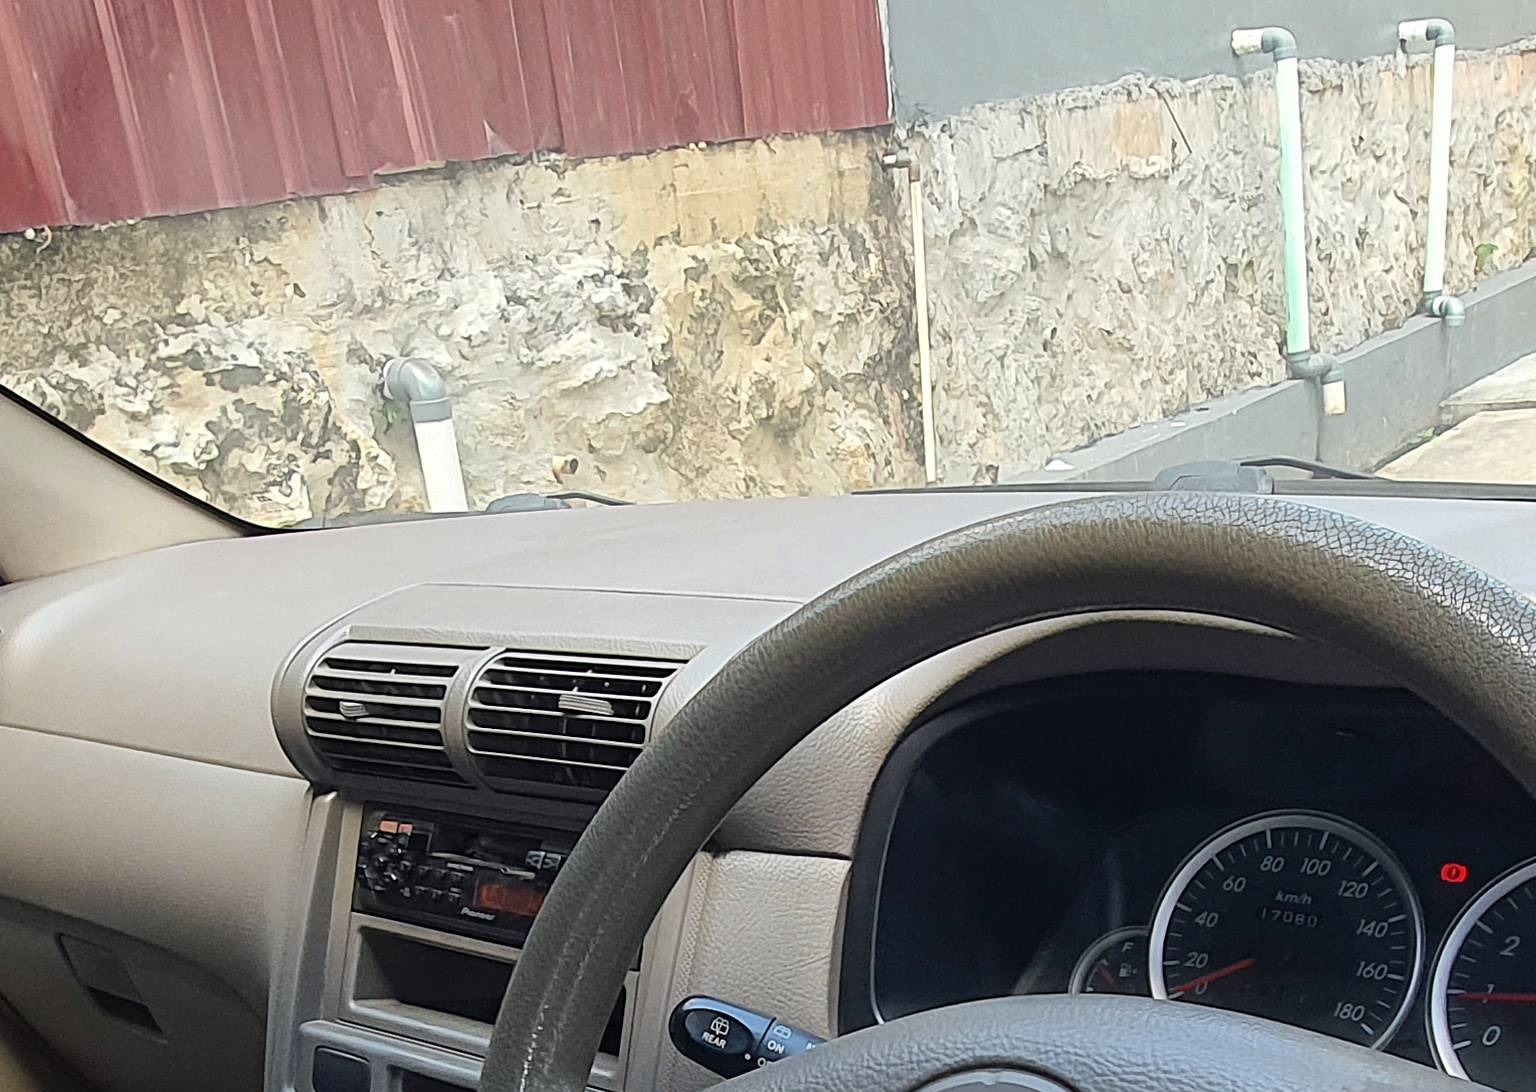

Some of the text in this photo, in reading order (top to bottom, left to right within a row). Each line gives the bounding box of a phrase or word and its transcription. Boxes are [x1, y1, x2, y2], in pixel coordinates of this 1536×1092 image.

[1259, 855, 1285, 873] 80
[1300, 857, 1332, 876] 100
[1222, 876, 1247, 892] 60
[1338, 880, 1369, 899] 120
[1275, 890, 1313, 905] km/h
[1194, 912, 1219, 928] 40
[1356, 919, 1389, 938] 140
[1121, 941, 1135, 952] F
[1499, 935, 1521, 956] 2
[1184, 951, 1209, 968] 20
[1356, 961, 1388, 980] 160
[1195, 979, 1208, 994] 0
[1333, 1002, 1365, 1021] 180
[701, 1031, 727, 1049] REAR
[1482, 1025, 1501, 1046] 0
[767, 1040, 785, 1054] ON
